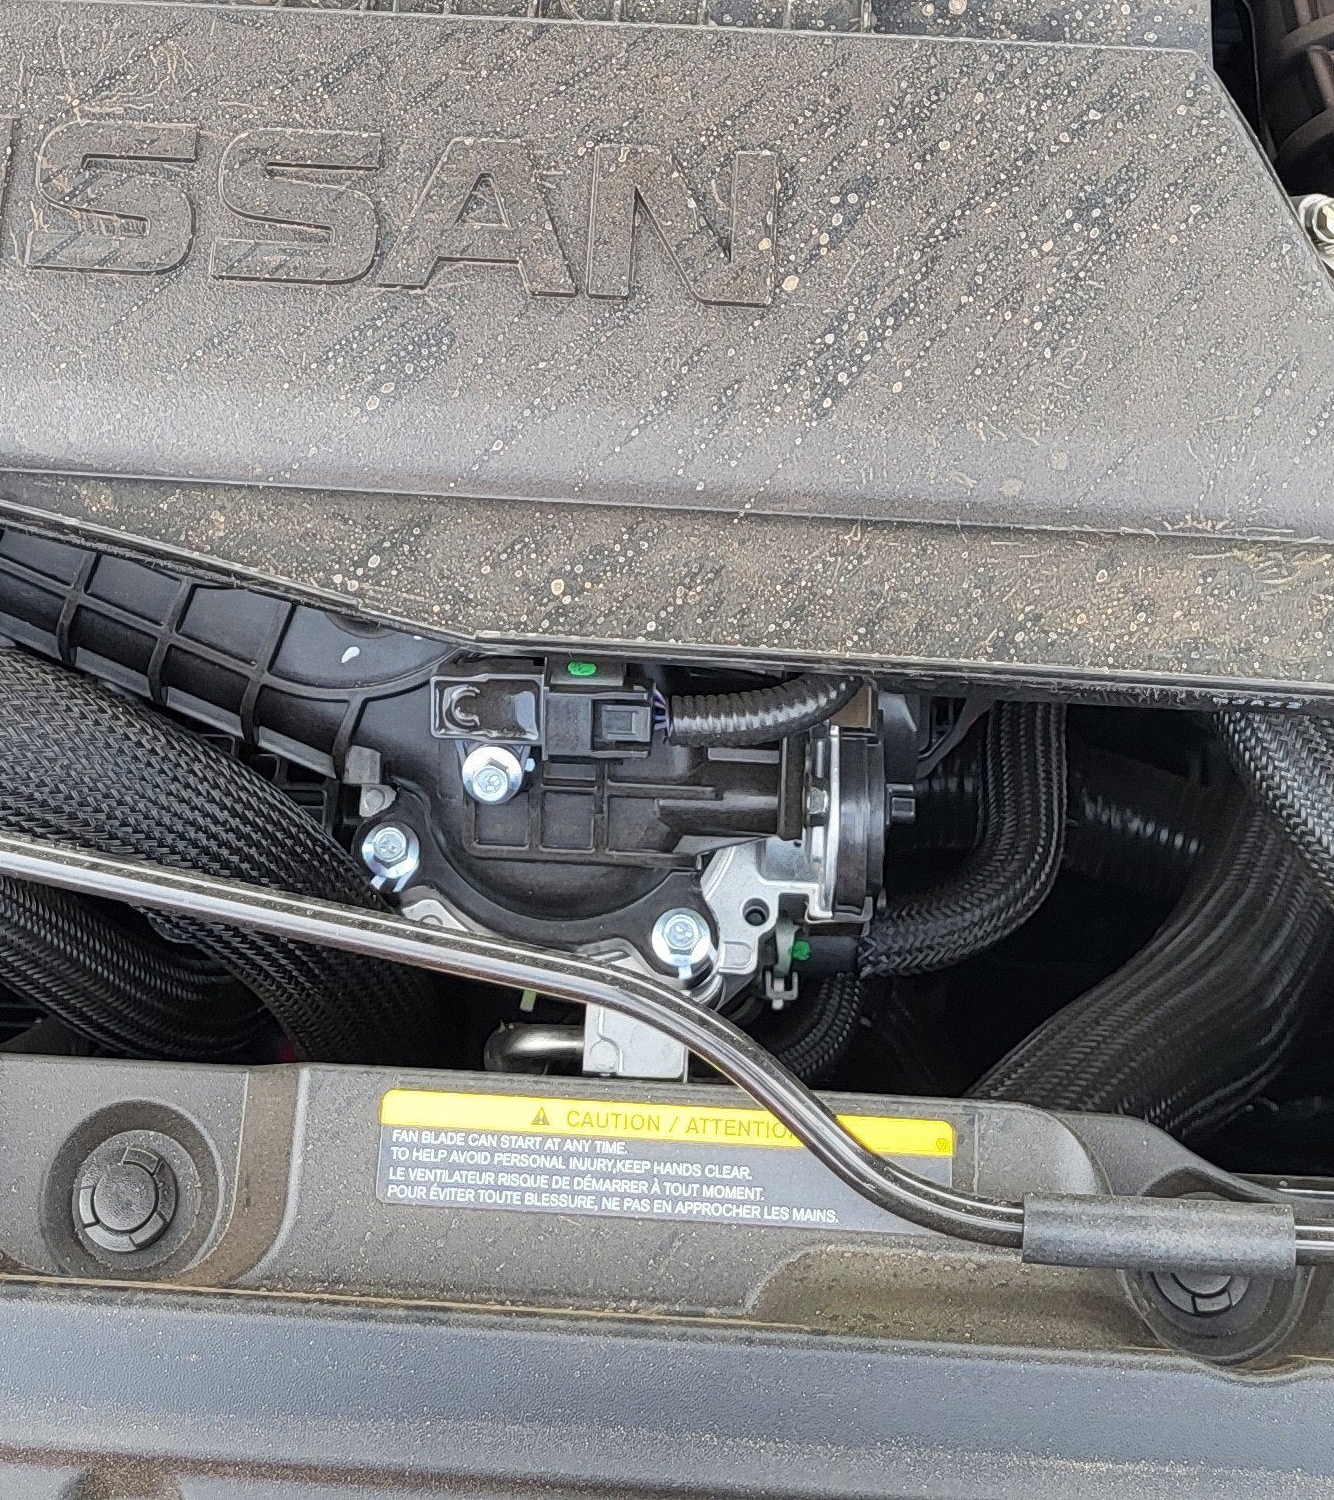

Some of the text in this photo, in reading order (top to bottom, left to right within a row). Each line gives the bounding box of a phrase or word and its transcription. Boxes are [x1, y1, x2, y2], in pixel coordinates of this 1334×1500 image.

[566, 1109, 794, 1140] CAUTION / ATTENTIO
[392, 1129, 628, 1155] FAN BLADE CAN START AT ANY TIME.
[390, 1146, 409, 1160] TO
[412, 1148, 447, 1162] HELP
[448, 1151, 491, 1165] AVOID
[493, 1152, 566, 1169] PERSONAL
[653, 1162, 701, 1177] HANDS
[704, 1165, 753, 1180] CLEAR.
[389, 1167, 765, 1201] LE VENTILATEUR RISQUE DE DÉMARRER À TOUT MOMENT.
[387, 1183, 839, 1223] POUR ÉVITER TOUTE BLESSURE, NE PAS EN APPROCHER LES MAINS.
